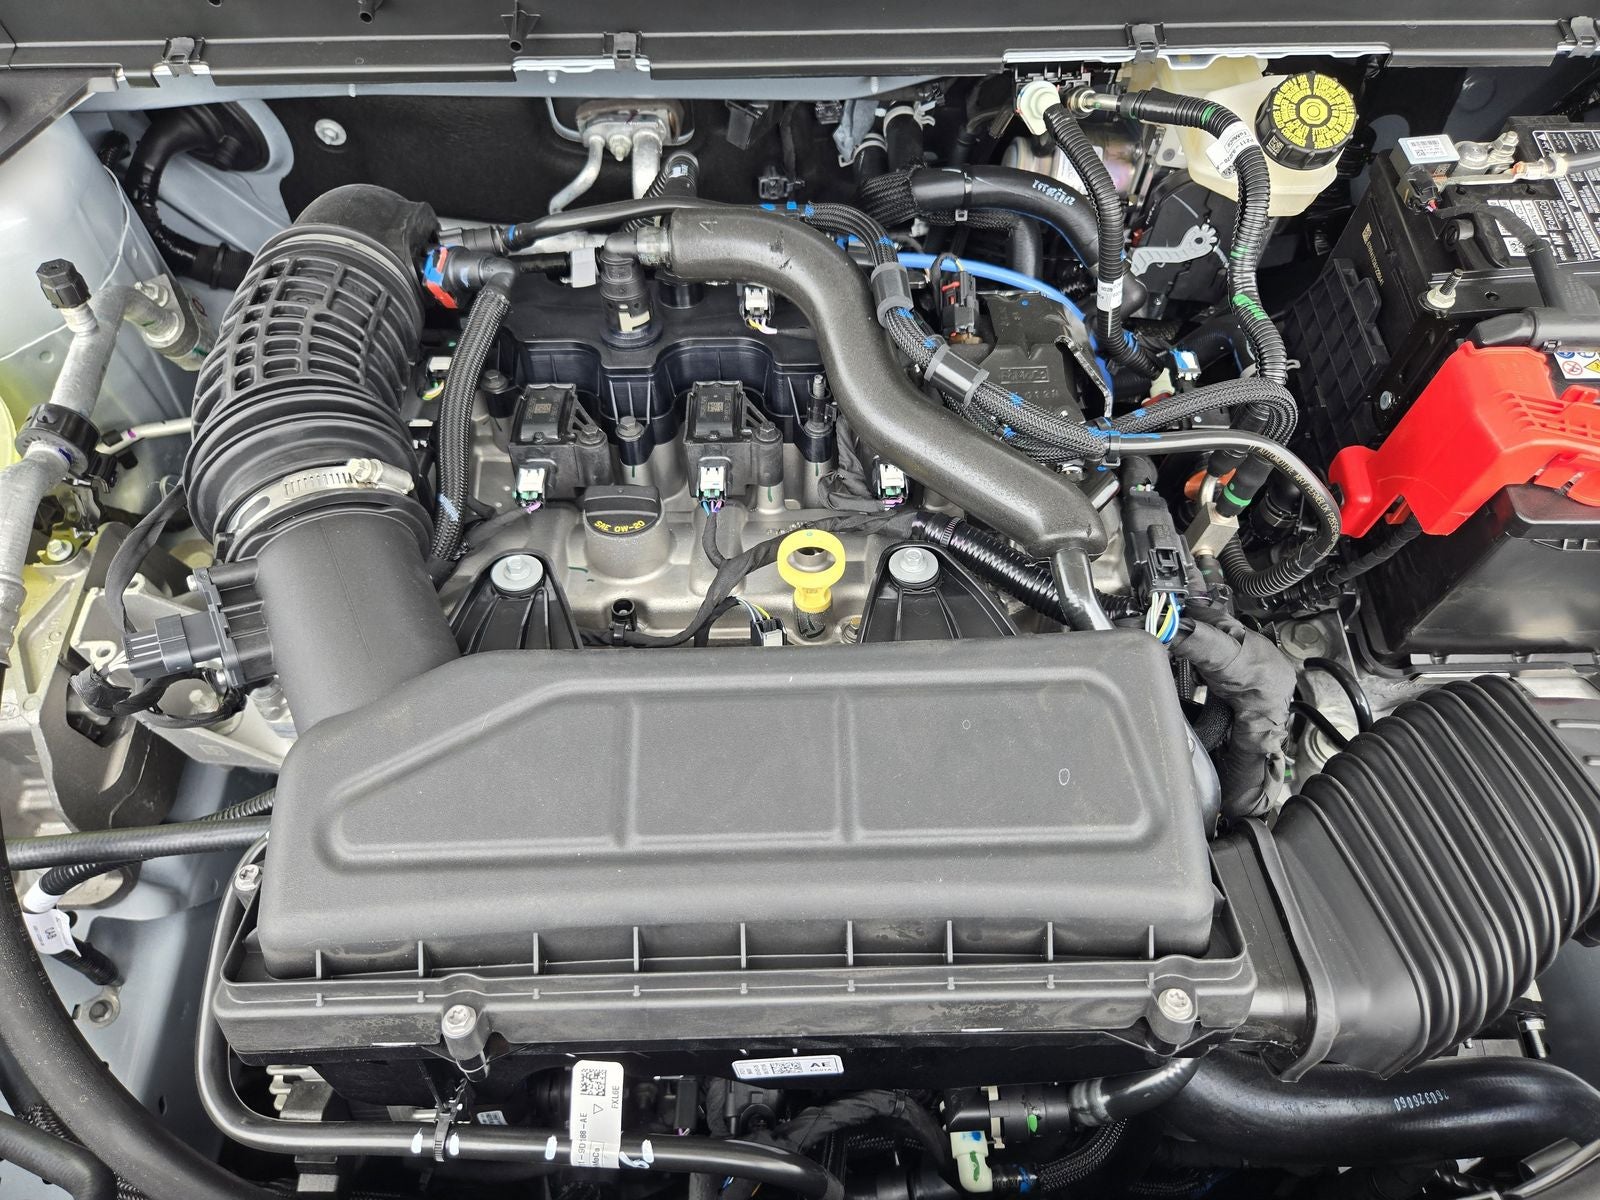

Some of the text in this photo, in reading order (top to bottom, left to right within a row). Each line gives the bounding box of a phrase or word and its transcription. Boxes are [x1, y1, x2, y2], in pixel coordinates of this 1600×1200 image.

[1539, 200, 1557, 230] FoMoCo
[594, 520, 611, 531] SAE
[611, 1085, 620, 1110] FXL6E
[592, 1147, 601, 1167] MoCo
